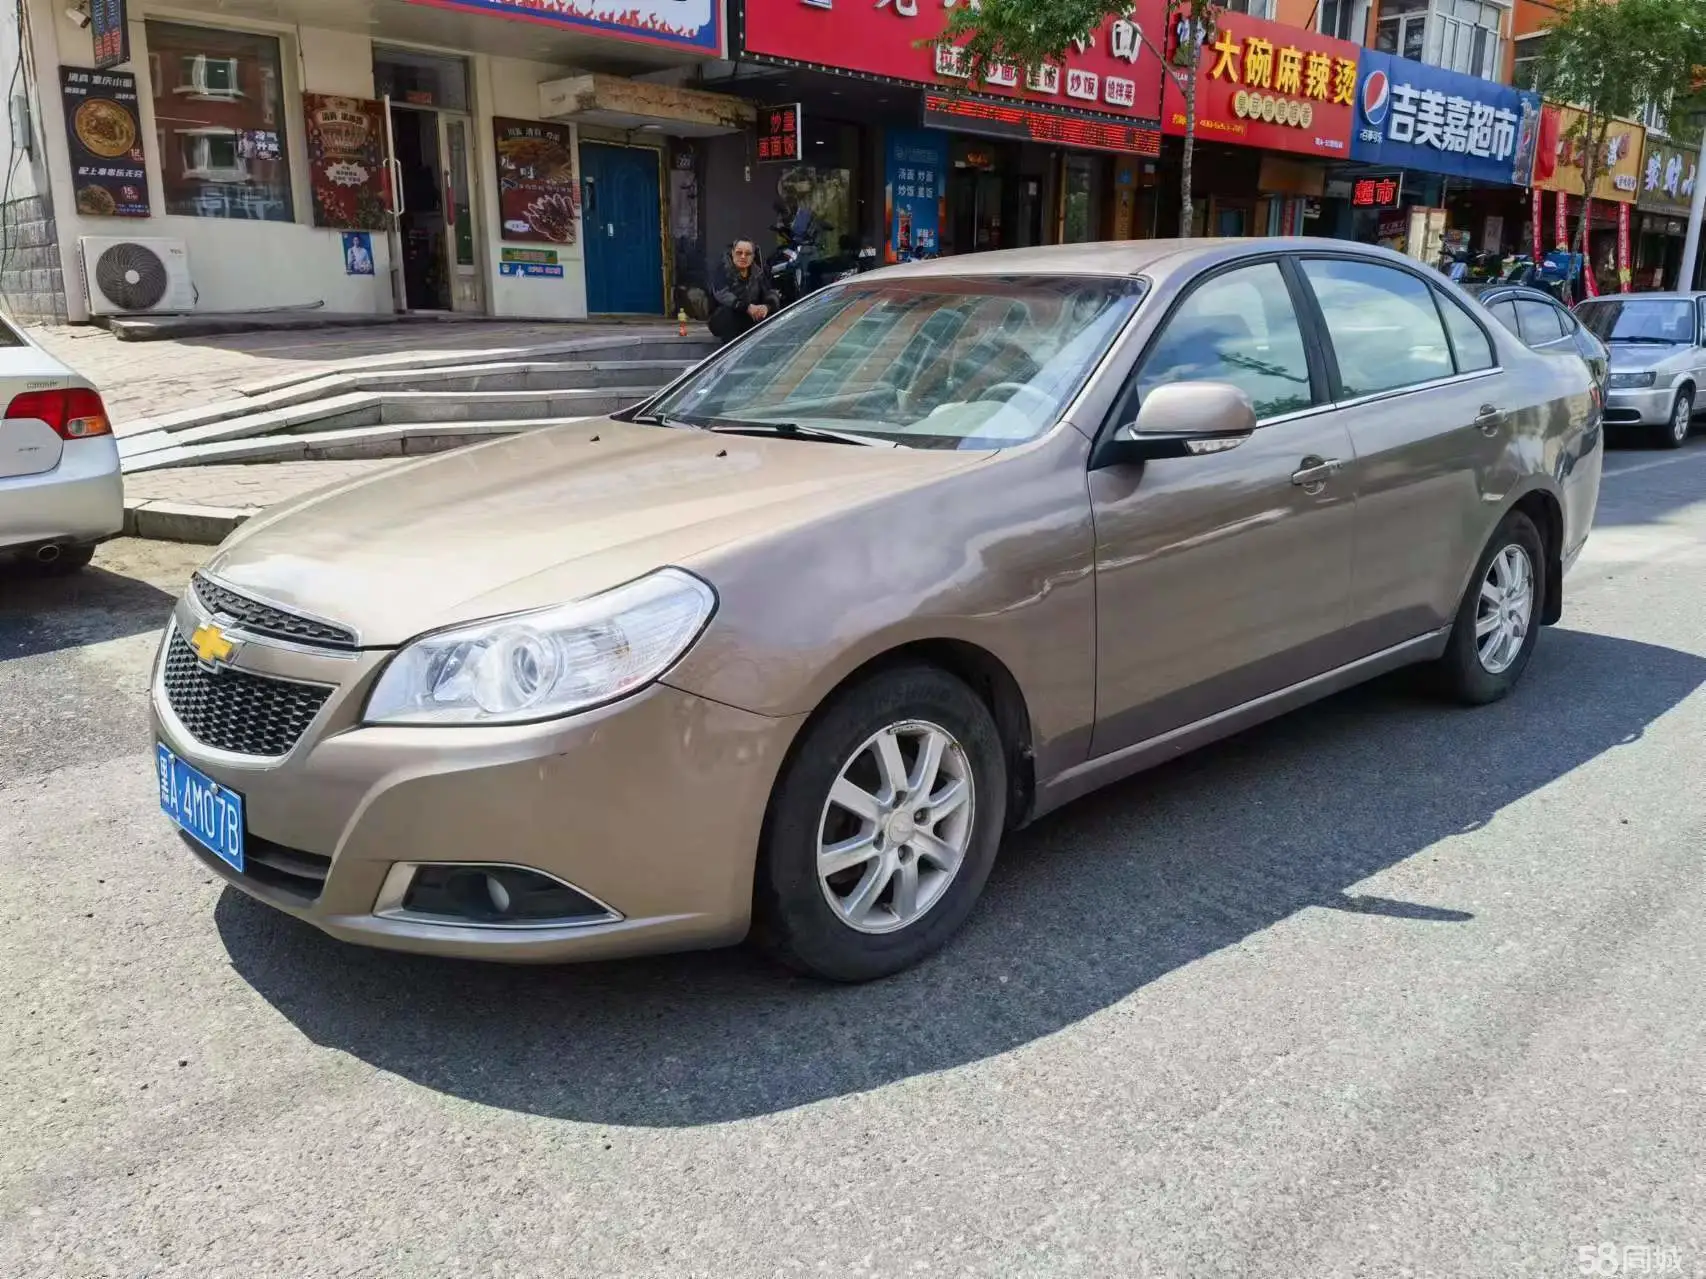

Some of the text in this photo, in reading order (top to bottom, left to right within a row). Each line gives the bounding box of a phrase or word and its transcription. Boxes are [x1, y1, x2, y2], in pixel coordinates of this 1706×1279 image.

[1070, 73, 1096, 95] 炒饭
[1212, 29, 1357, 105] 大碗麻辣烫
[1388, 83, 1517, 161] 吉美嘉超市
[1353, 179, 1397, 205] 超市
